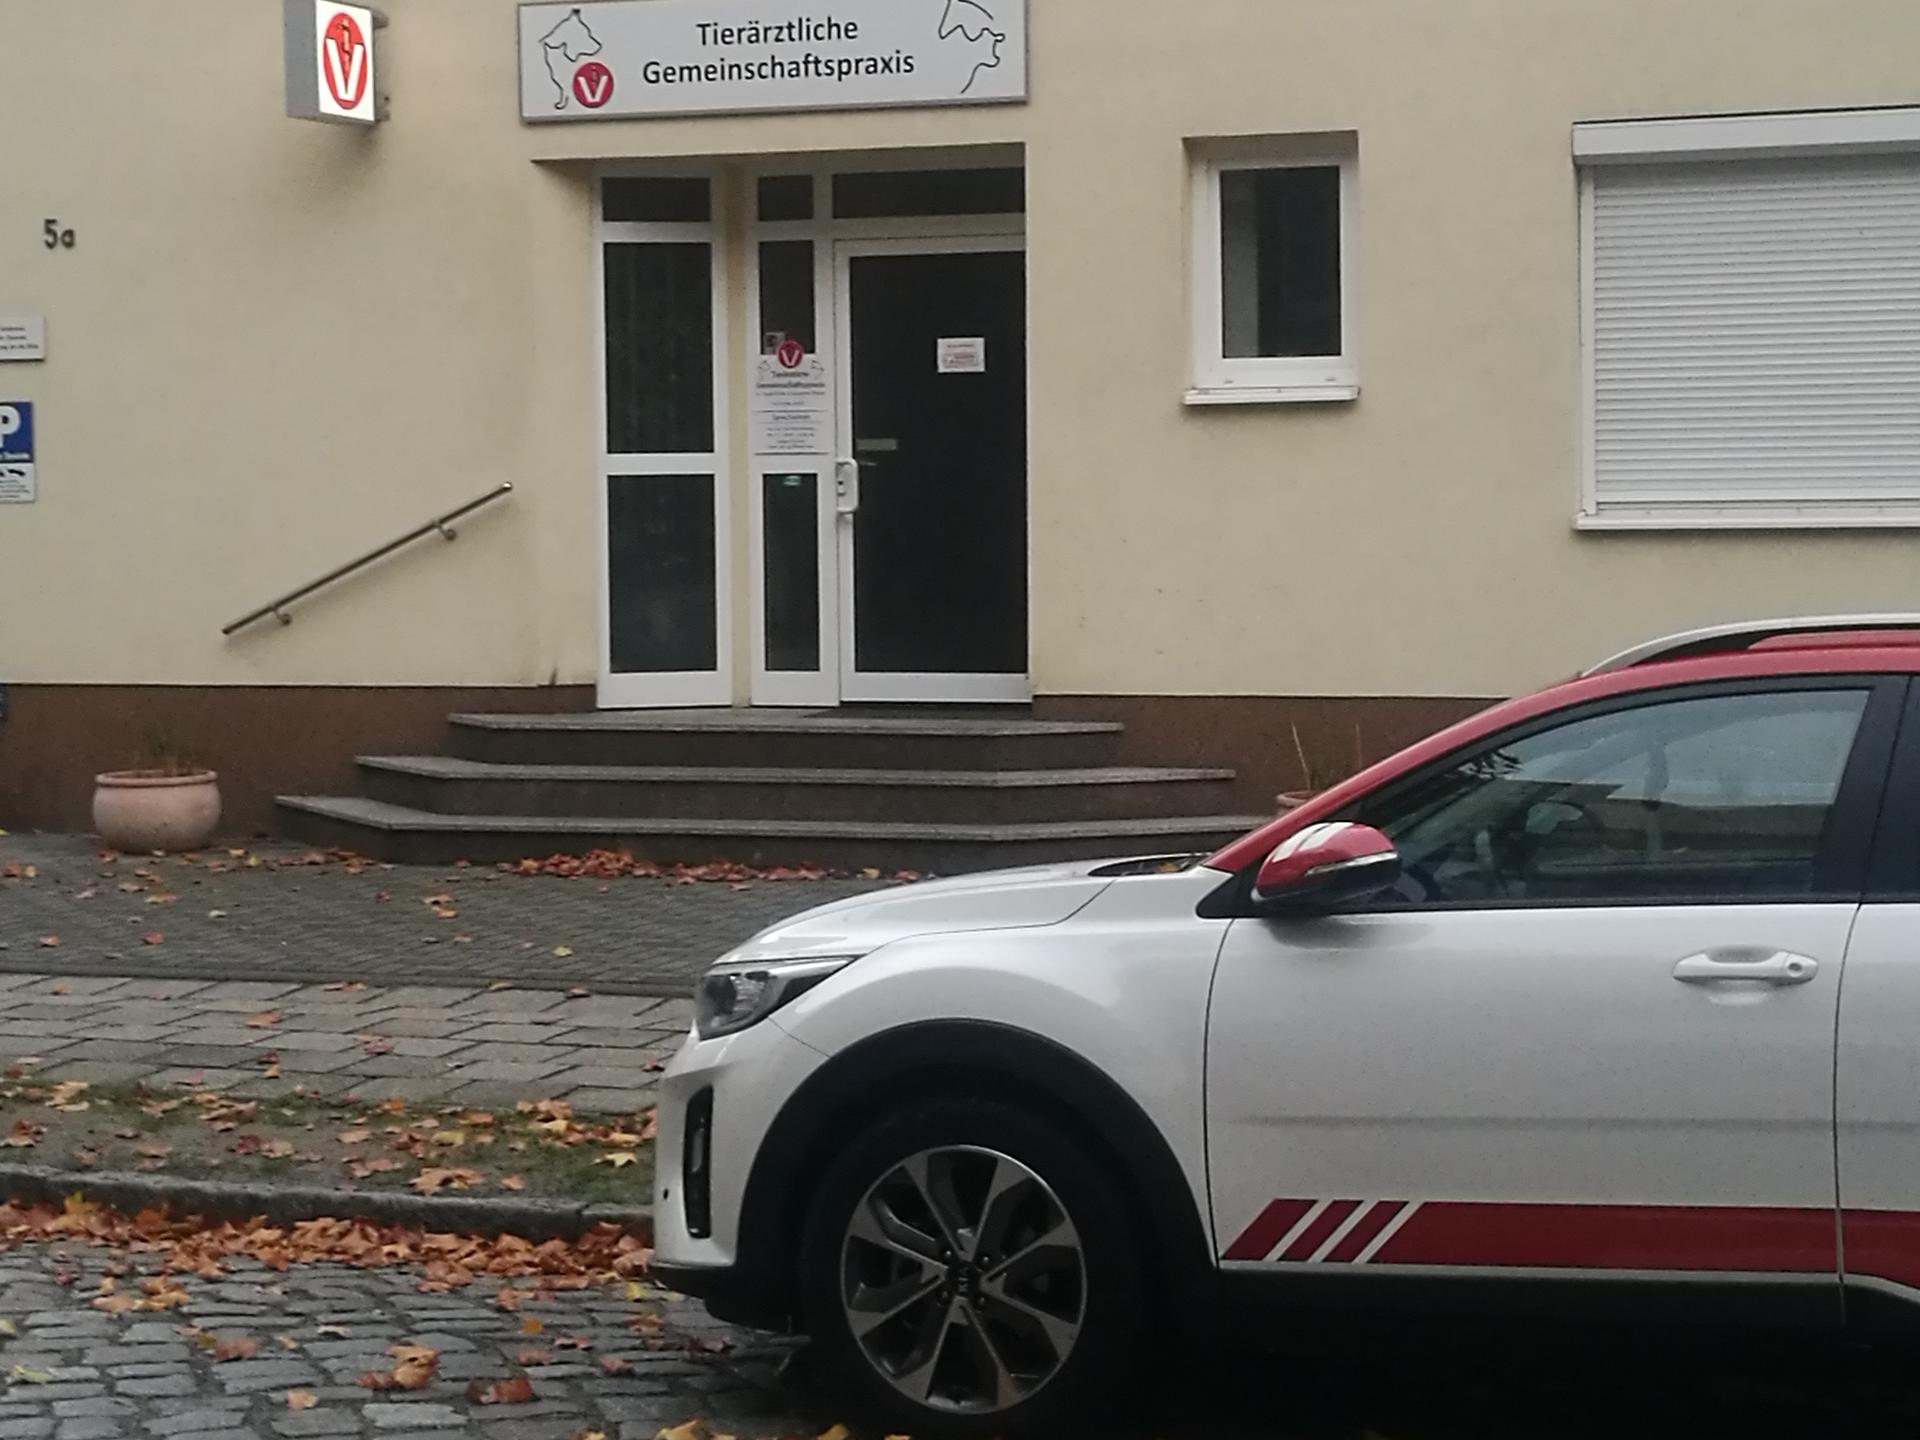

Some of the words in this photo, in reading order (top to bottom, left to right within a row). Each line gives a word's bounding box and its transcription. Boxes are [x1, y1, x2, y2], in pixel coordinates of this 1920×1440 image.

[696, 16, 859, 46] Tierärztliche
[325, 37, 365, 102] V
[642, 49, 915, 84] Gemeinschaftspraxis
[43, 218, 76, 250] 5a
[0, 406, 21, 449] P
